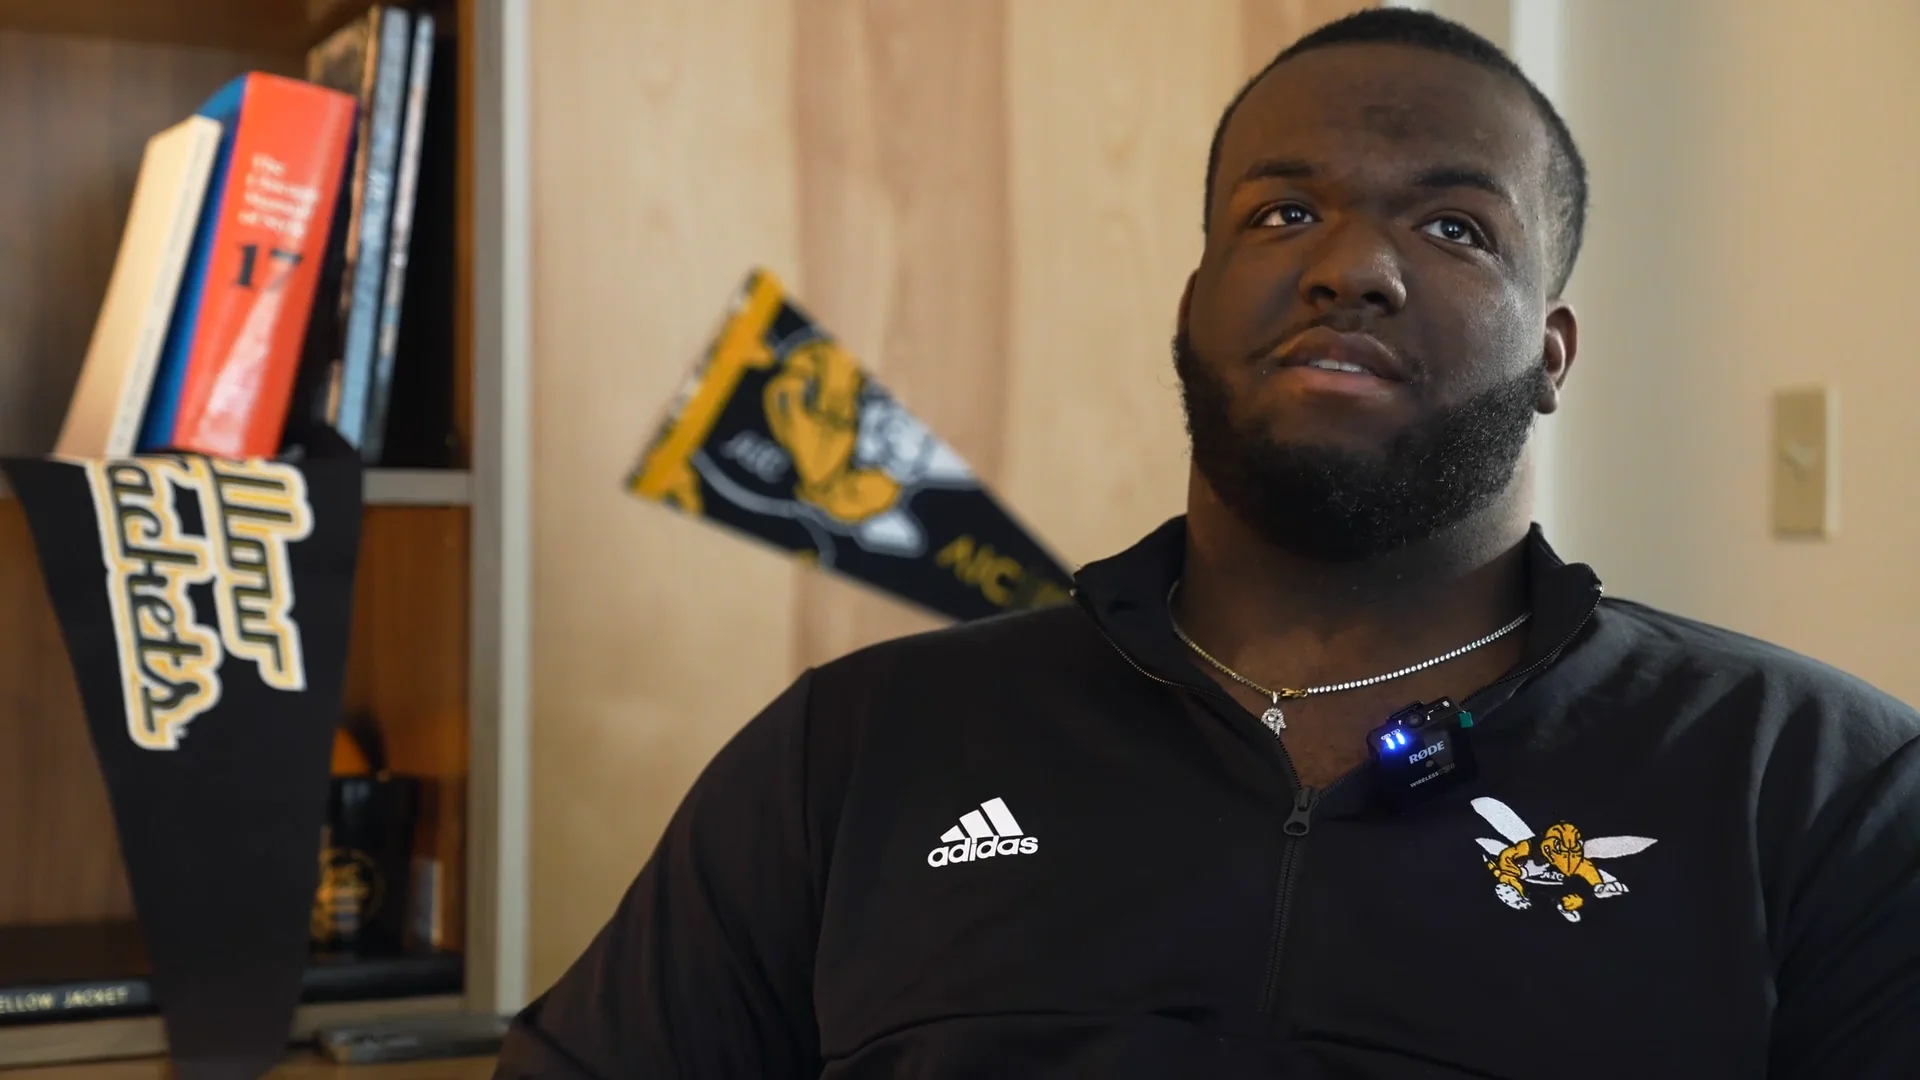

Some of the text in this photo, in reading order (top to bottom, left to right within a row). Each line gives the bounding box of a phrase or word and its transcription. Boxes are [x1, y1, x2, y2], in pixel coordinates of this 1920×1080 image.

[234, 243, 304, 289] 17
[202, 457, 303, 684] llow
[93, 457, 213, 744] ackets
[1408, 740, 1446, 765] RØDE
[1409, 770, 1440, 788] WIRELESS
[927, 835, 1039, 867] adidas
[0, 985, 129, 1014] ELLOW JACKET
